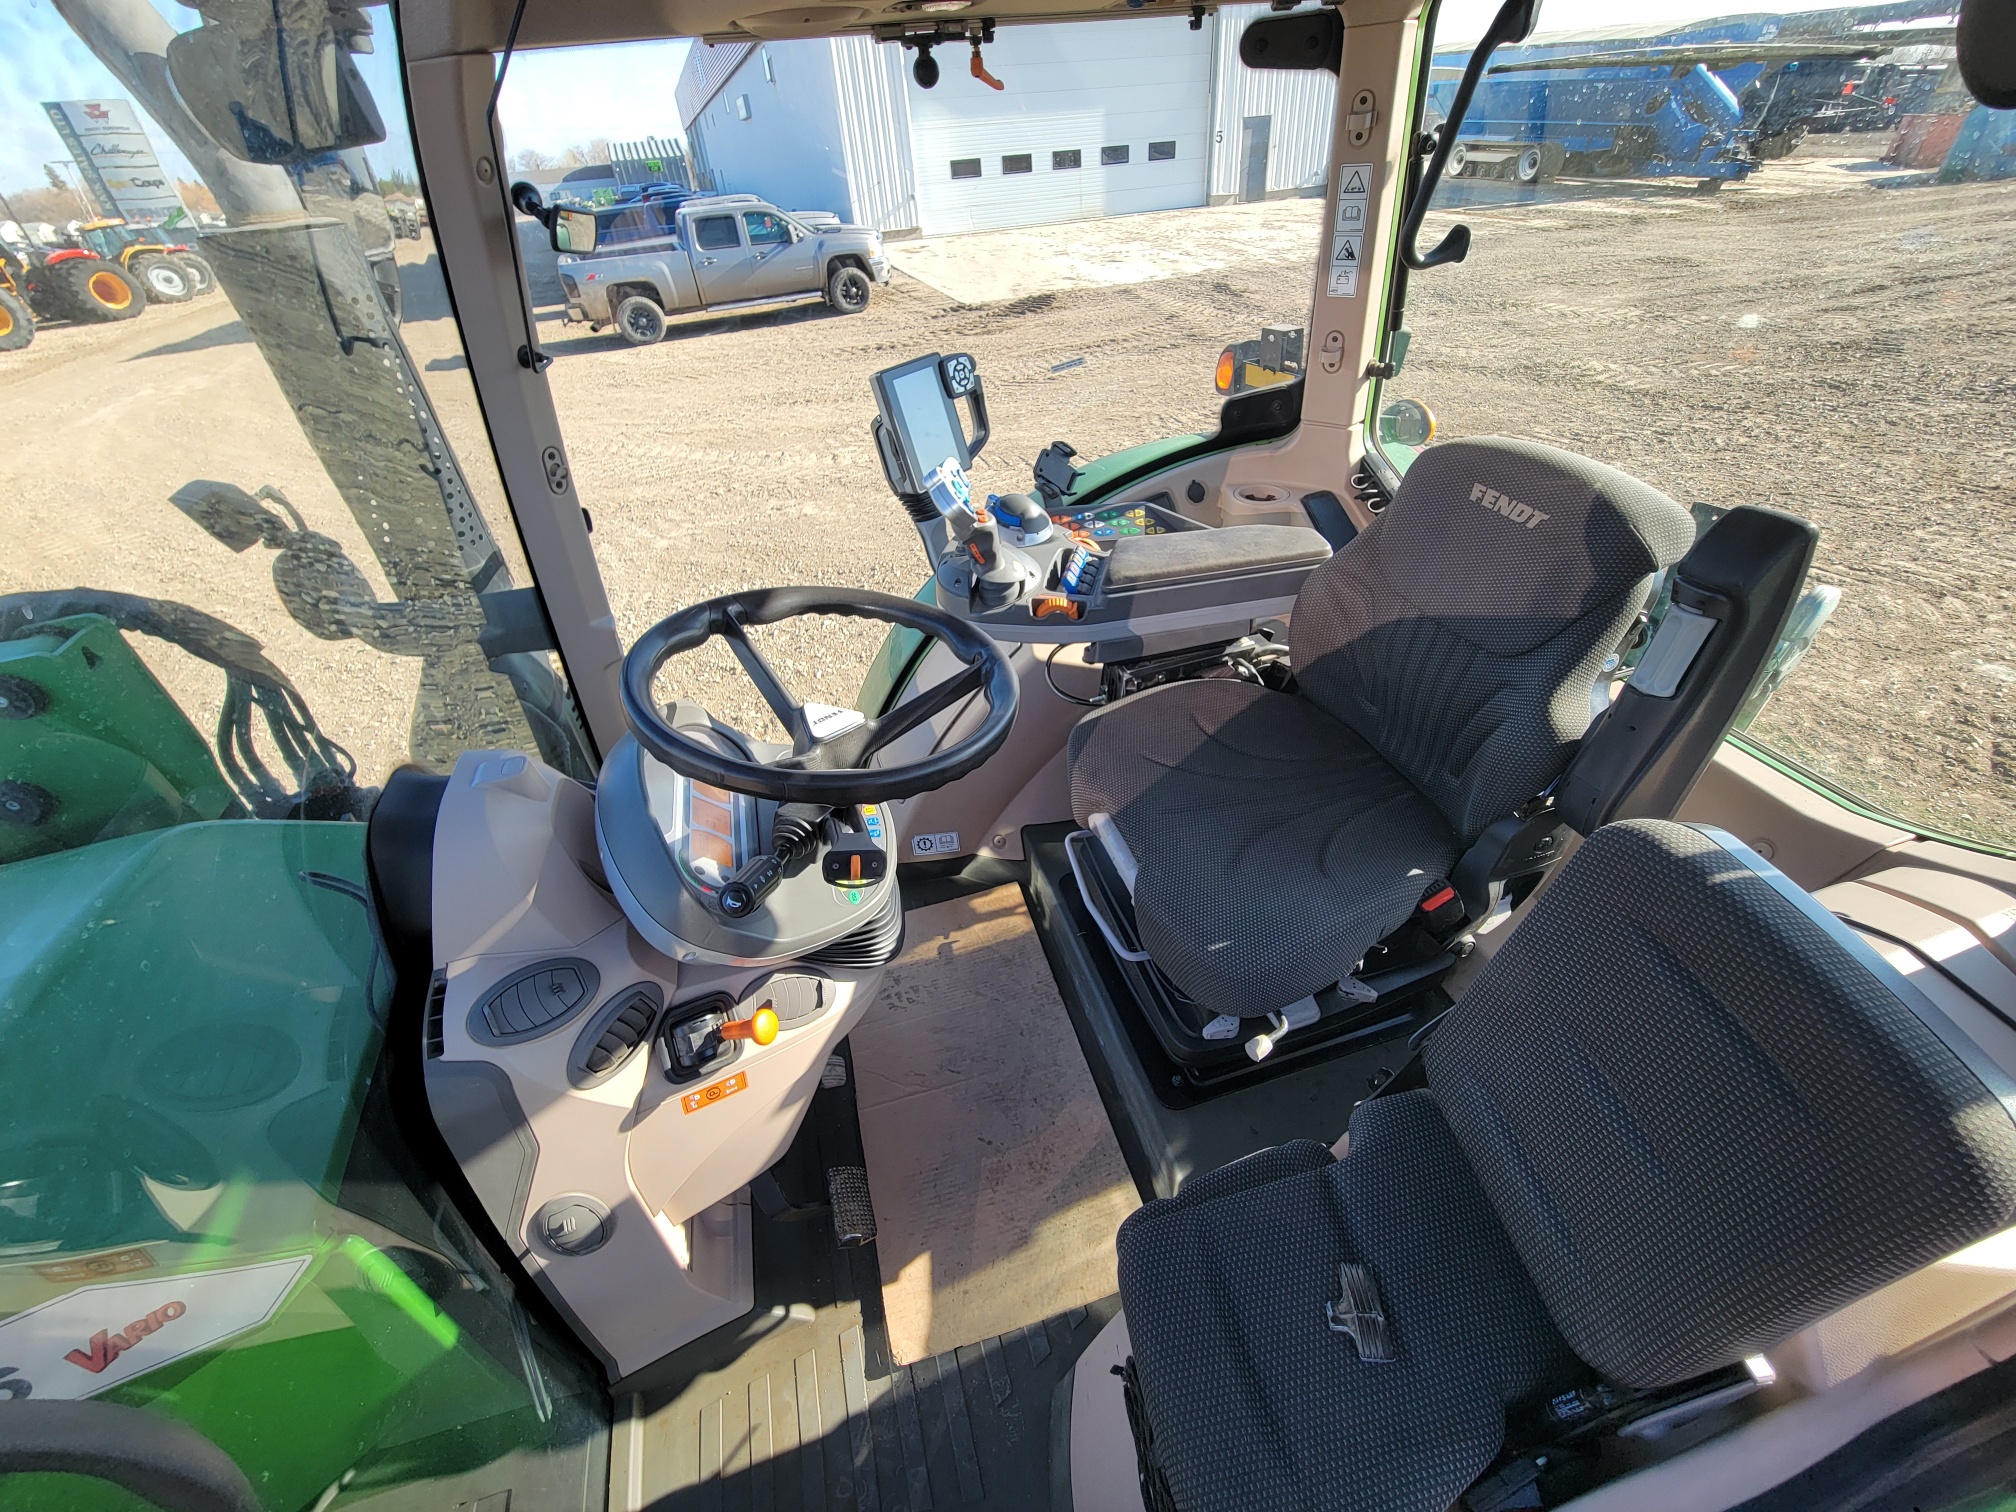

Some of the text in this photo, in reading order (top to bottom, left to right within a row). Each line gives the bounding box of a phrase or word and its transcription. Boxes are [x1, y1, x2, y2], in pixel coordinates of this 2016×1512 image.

[1215, 130, 1223, 144] 5
[1468, 482, 1551, 530] FENDT
[63, 1300, 187, 1374] VARIO
